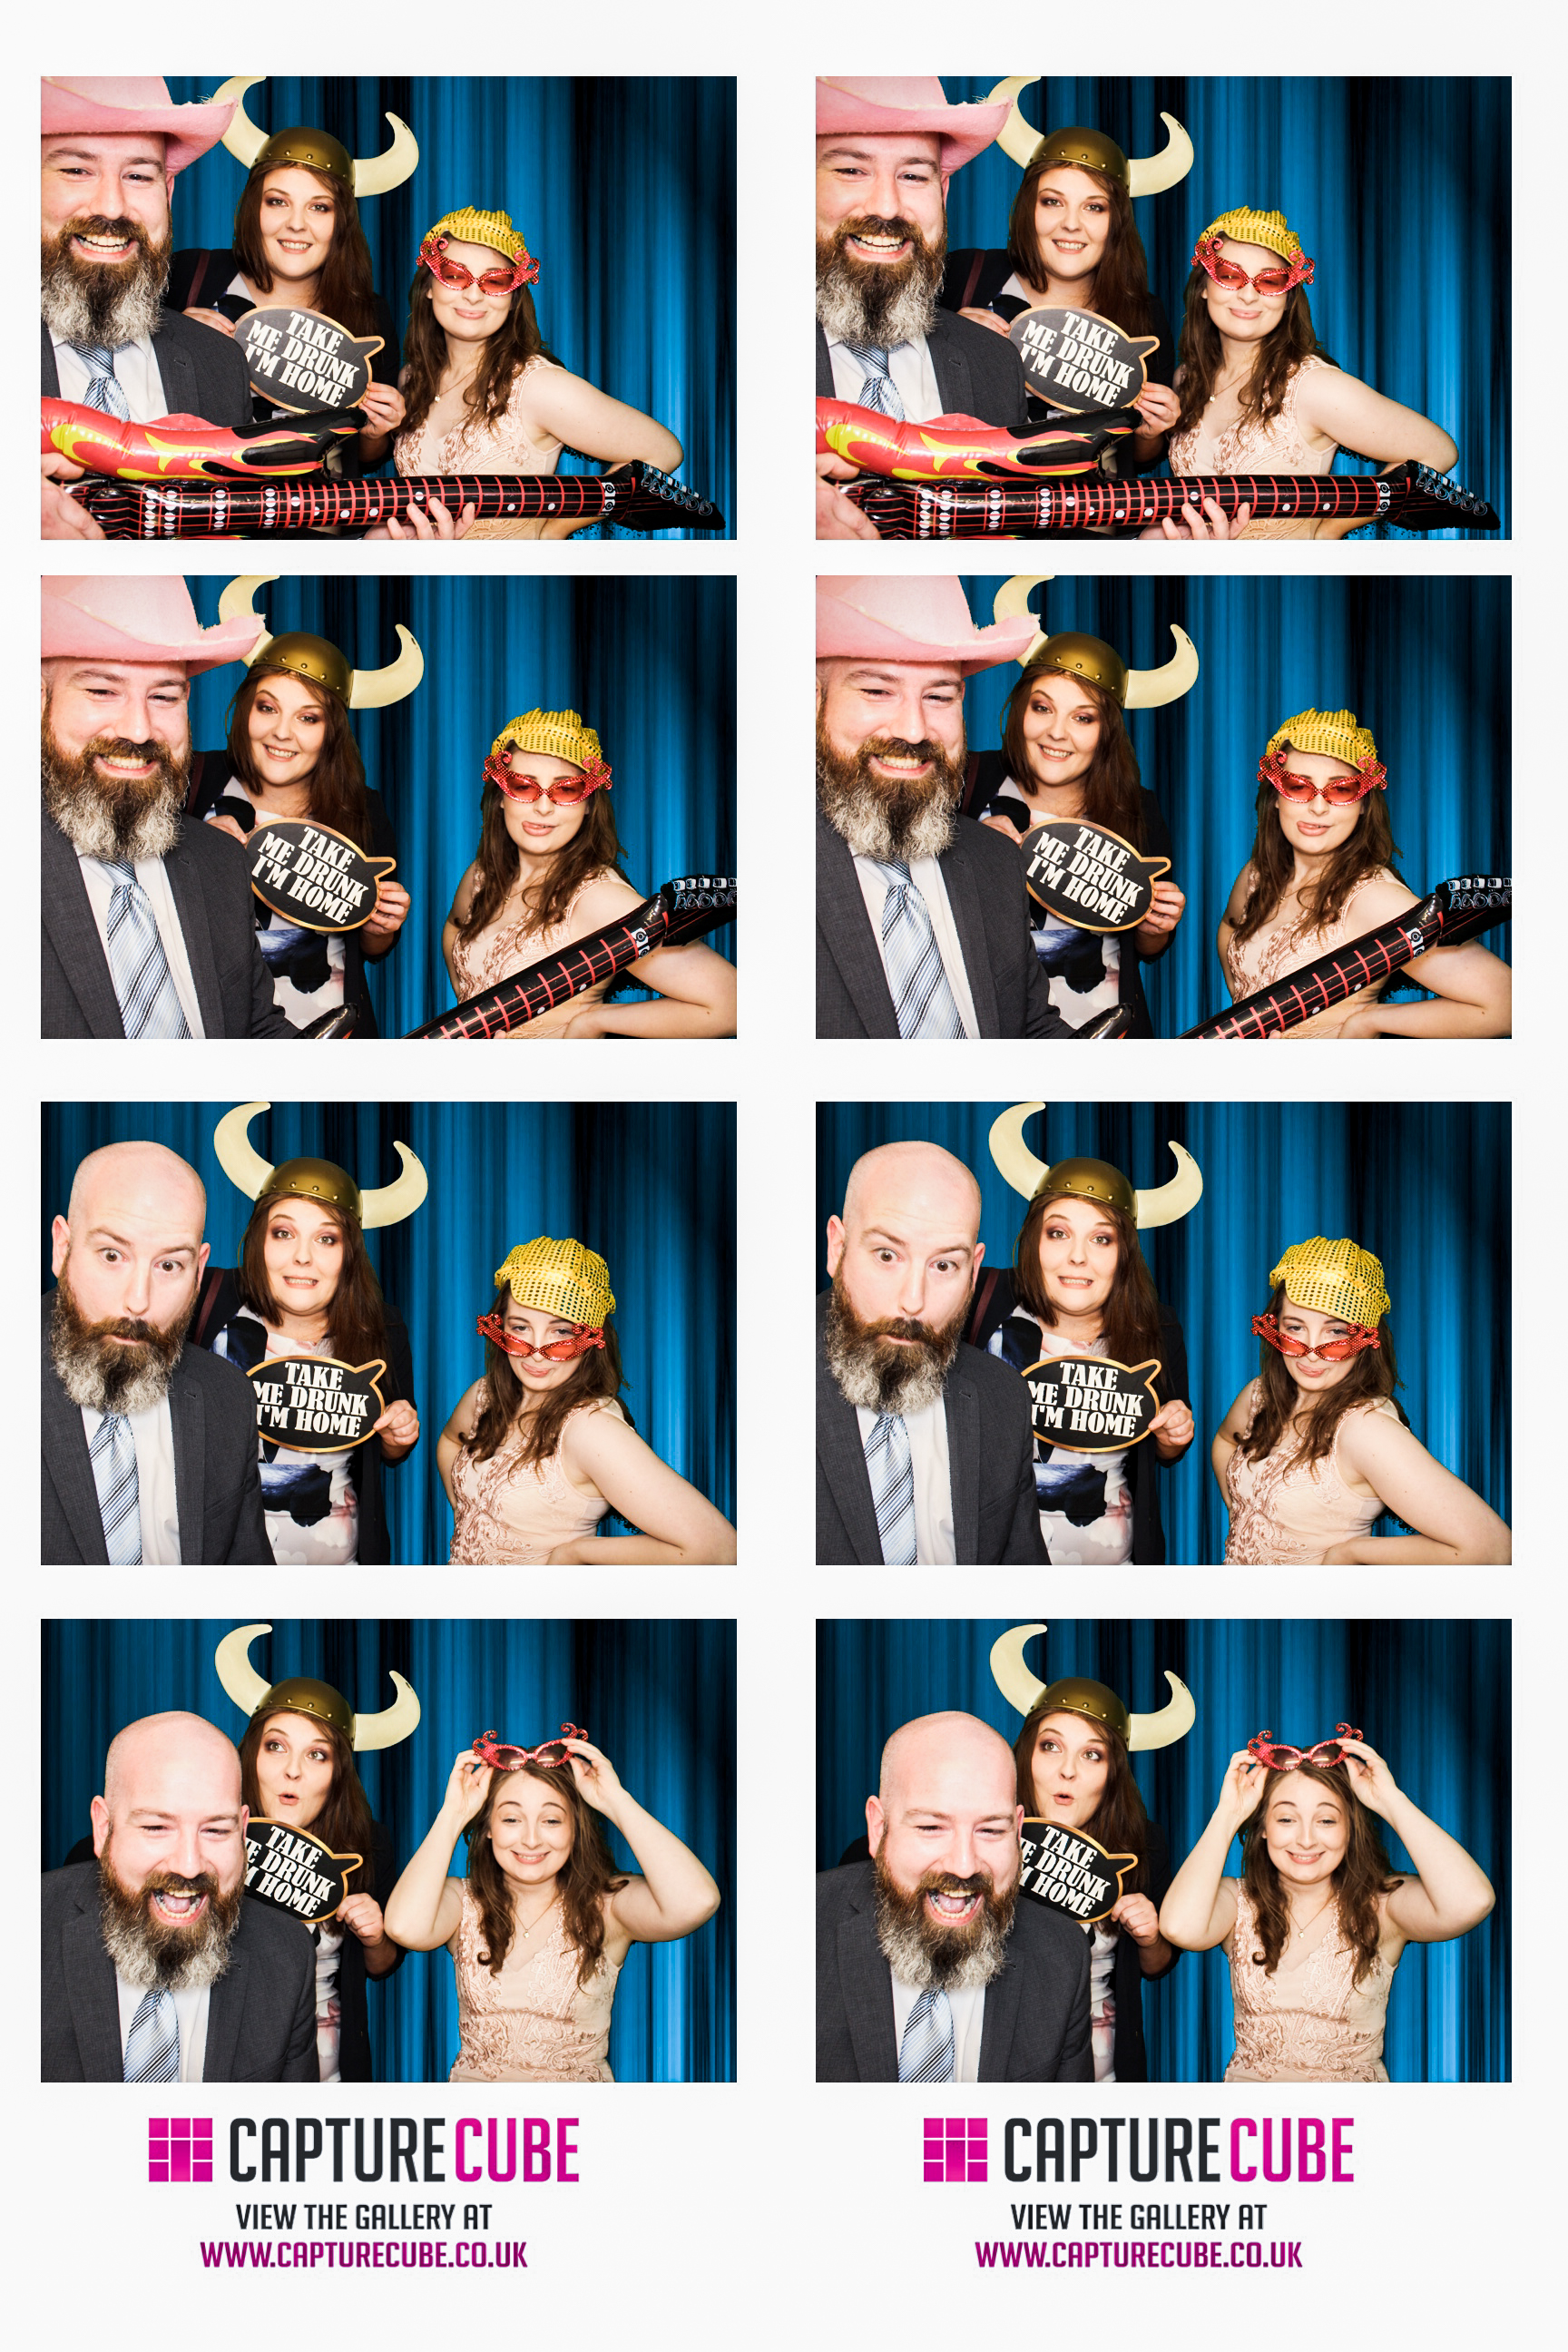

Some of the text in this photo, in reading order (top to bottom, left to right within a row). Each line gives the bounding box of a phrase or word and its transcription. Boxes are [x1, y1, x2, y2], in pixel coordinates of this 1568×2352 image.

[246, 319, 359, 389] ME DRUNK
[286, 311, 344, 355] TAKE
[1021, 319, 1134, 389] ME DRUNK
[1061, 311, 1119, 355] TAKE
[279, 361, 346, 407] HOME
[1054, 361, 1121, 407] HOME
[258, 831, 368, 907] ME DRUNK
[298, 826, 356, 873] TAKE
[1033, 831, 1143, 907] ME DRUNK
[1073, 826, 1131, 873] TAKE
[251, 854, 354, 925] I'M HOME
[1026, 854, 1129, 925] I'M HOME
[252, 1380, 368, 1416] ME DRUNK
[285, 1361, 344, 1391] TAKE
[1027, 1380, 1143, 1416] ME DRUNK
[1060, 1361, 1119, 1391] TAKE
[256, 1404, 361, 1437] I'M HOME
[1031, 1404, 1136, 1437] I'M HOME
[245, 1837, 262, 1864] E
[260, 1848, 337, 1902] DRUNK
[265, 1825, 323, 1870] TAKE
[1020, 1837, 1037, 1864] E
[1034, 1848, 1112, 1902] DRUNK
[1040, 1825, 1098, 1870] TAKE
[256, 1872, 321, 1918] HOME
[1031, 1872, 1096, 1918] HOME
